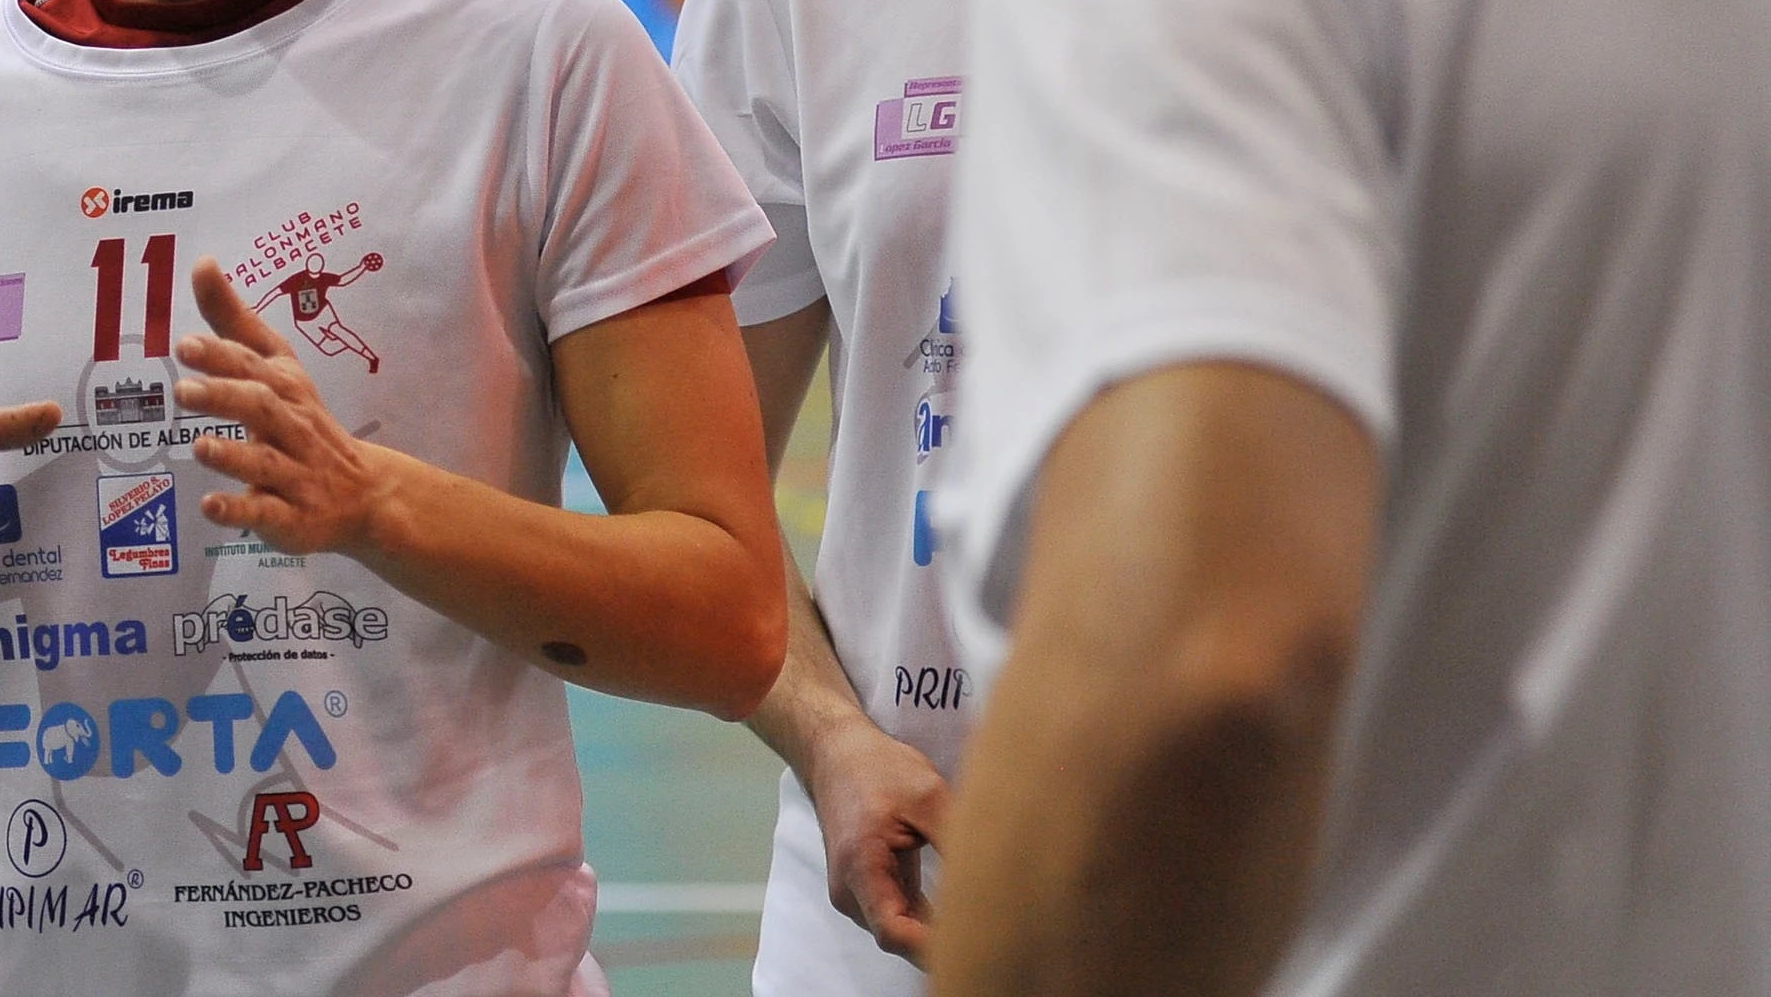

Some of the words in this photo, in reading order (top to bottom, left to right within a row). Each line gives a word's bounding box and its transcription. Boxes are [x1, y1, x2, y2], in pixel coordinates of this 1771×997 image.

[906, 101, 956, 133] LG
[113, 188, 194, 214] irema
[254, 211, 312, 250] CLUB
[244, 216, 363, 288] ALBACETE
[90, 234, 177, 362] 11
[129, 431, 152, 447] DE
[108, 481, 150, 512] SILVERIO
[133, 478, 171, 508] PELAYO
[2, 545, 63, 568] dental
[109, 546, 170, 562] Legumbres
[205, 543, 247, 558] INSTITUTO
[258, 555, 307, 568] ALBACETE
[173, 595, 388, 656] prédase
[229, 650, 280, 663] Protección
[284, 649, 298, 660] de
[301, 649, 328, 660] datos
[23, 808, 48, 866] P
[174, 873, 413, 903] FERNÁNDEZ-PACHECO
[224, 904, 362, 928] INGENIEROS
